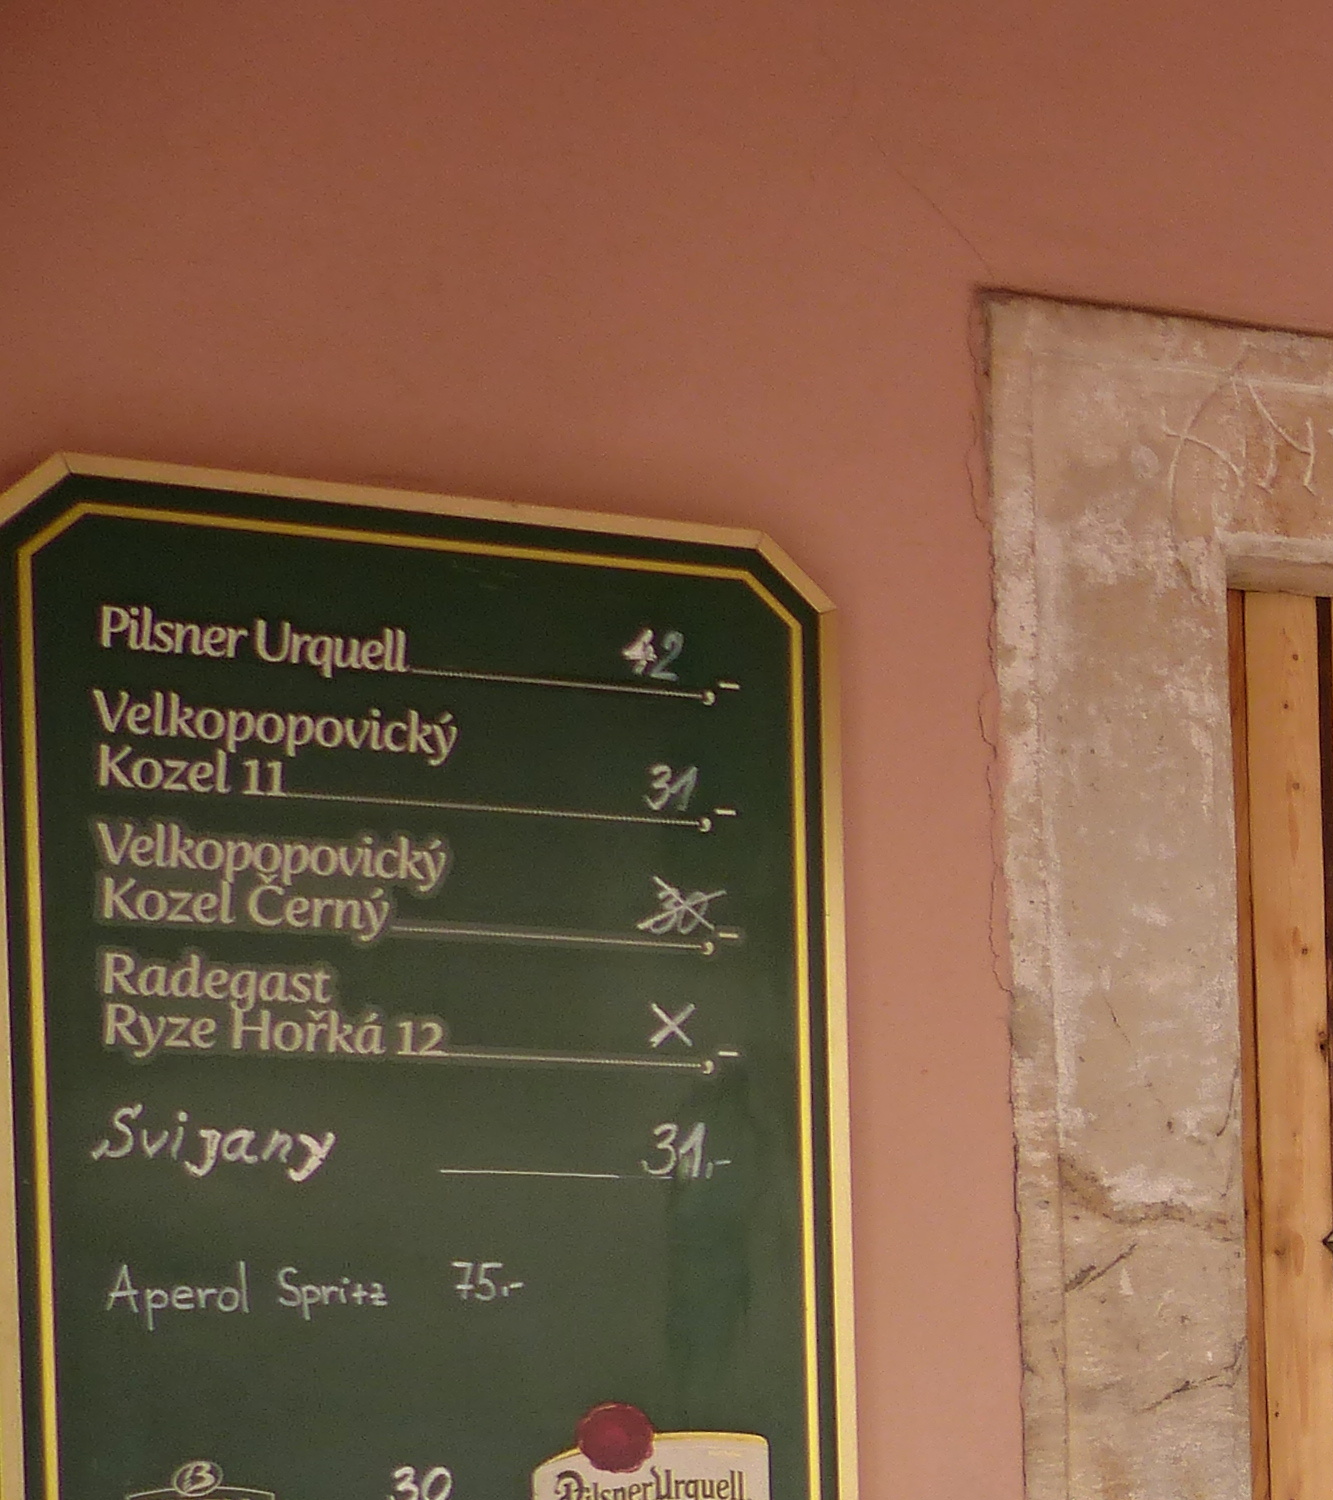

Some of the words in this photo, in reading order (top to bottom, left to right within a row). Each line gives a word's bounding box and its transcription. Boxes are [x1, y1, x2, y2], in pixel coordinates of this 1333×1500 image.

[101, 605, 248, 658] Pilsner
[254, 617, 407, 679] Urquell
[93, 688, 458, 766] Velkopopovický
[99, 743, 231, 793] Kozel
[242, 758, 287, 796] 11
[96, 821, 447, 892] Velkopopovický
[102, 877, 235, 924] Kozel
[249, 872, 391, 941] Černý
[103, 951, 332, 1012] Radegast
[104, 1002, 217, 1058] Ryze
[231, 1007, 386, 1054] Hořká
[397, 1021, 445, 1056] 12
[91, 1103, 336, 1182] Svijany
[106, 1260, 250, 1332] Aperol
[278, 1266, 389, 1321] Spritz
